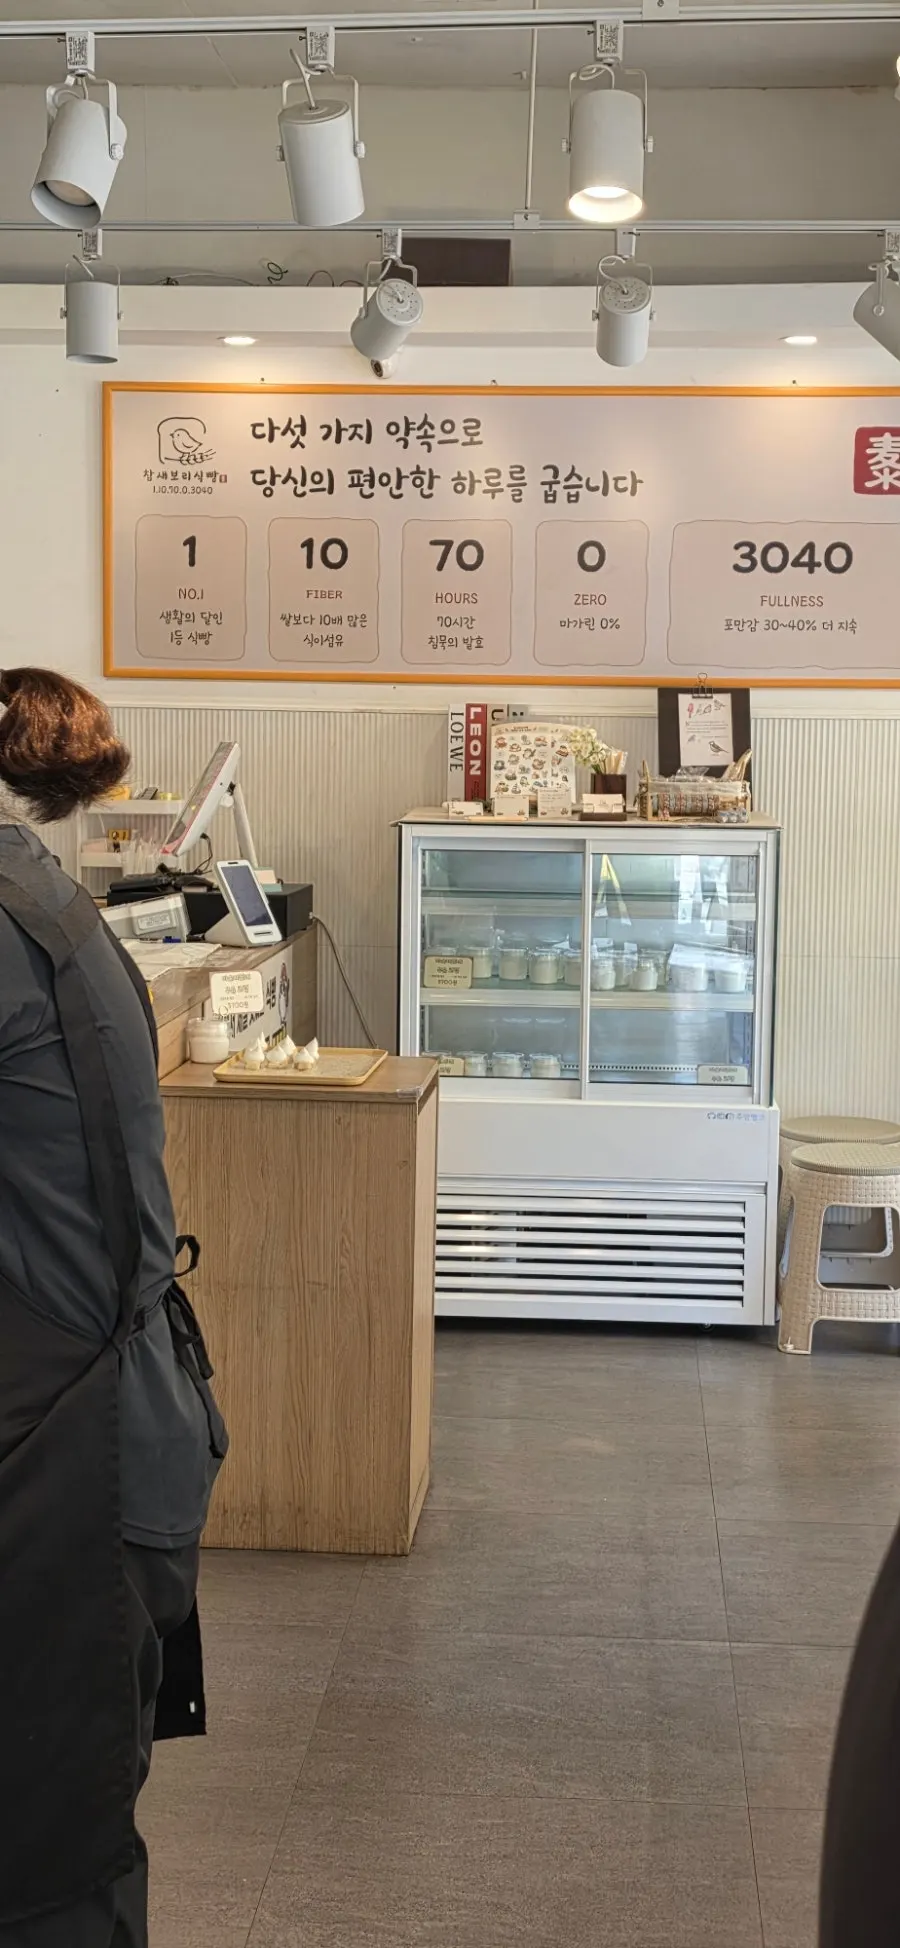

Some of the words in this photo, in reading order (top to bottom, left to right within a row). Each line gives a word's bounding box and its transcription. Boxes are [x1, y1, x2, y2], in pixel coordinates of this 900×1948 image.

[251, 415, 306, 449] 다섯
[320, 418, 372, 444] 가지
[386, 413, 482, 453] 약속으로
[144, 469, 219, 483] 참새보리식빵
[153, 486, 213, 494] 1.10.70.0.3040
[250, 466, 334, 498] 당신의
[348, 465, 440, 499] 편안한
[451, 465, 527, 503] 하루를
[540, 465, 643, 504] 굽습니다
[183, 536, 196, 567] 1
[301, 538, 348, 569] 10
[429, 540, 484, 571] 70
[577, 540, 606, 572] 0
[733, 541, 853, 574] 3040
[179, 588, 203, 600] NO.1
[307, 590, 342, 599] FIBER
[436, 593, 477, 604] HOURS
[574, 594, 606, 605] ZERO
[760, 595, 823, 607] FULLNESS
[160, 609, 195, 625] 생활의
[199, 611, 223, 625] 달인
[280, 613, 315, 627] 쌀보다
[320, 615, 342, 625] 10배
[347, 614, 367, 628] 많은
[437, 616, 475, 629] 70시간
[560, 617, 594, 631] 마가린
[600, 618, 620, 629] 0%
[724, 619, 759, 632] 포만감
[764, 619, 816, 631] 30~40%
[822, 620, 833, 631] 더
[838, 619, 857, 634] 지속
[170, 630, 184, 645] 1등
[188, 632, 213, 645] 식빵
[304, 634, 343, 648] 식이섬유
[428, 635, 457, 650] 침묵의
[450, 711, 464, 772] LOEWE
[470, 707, 482, 775] LEON
